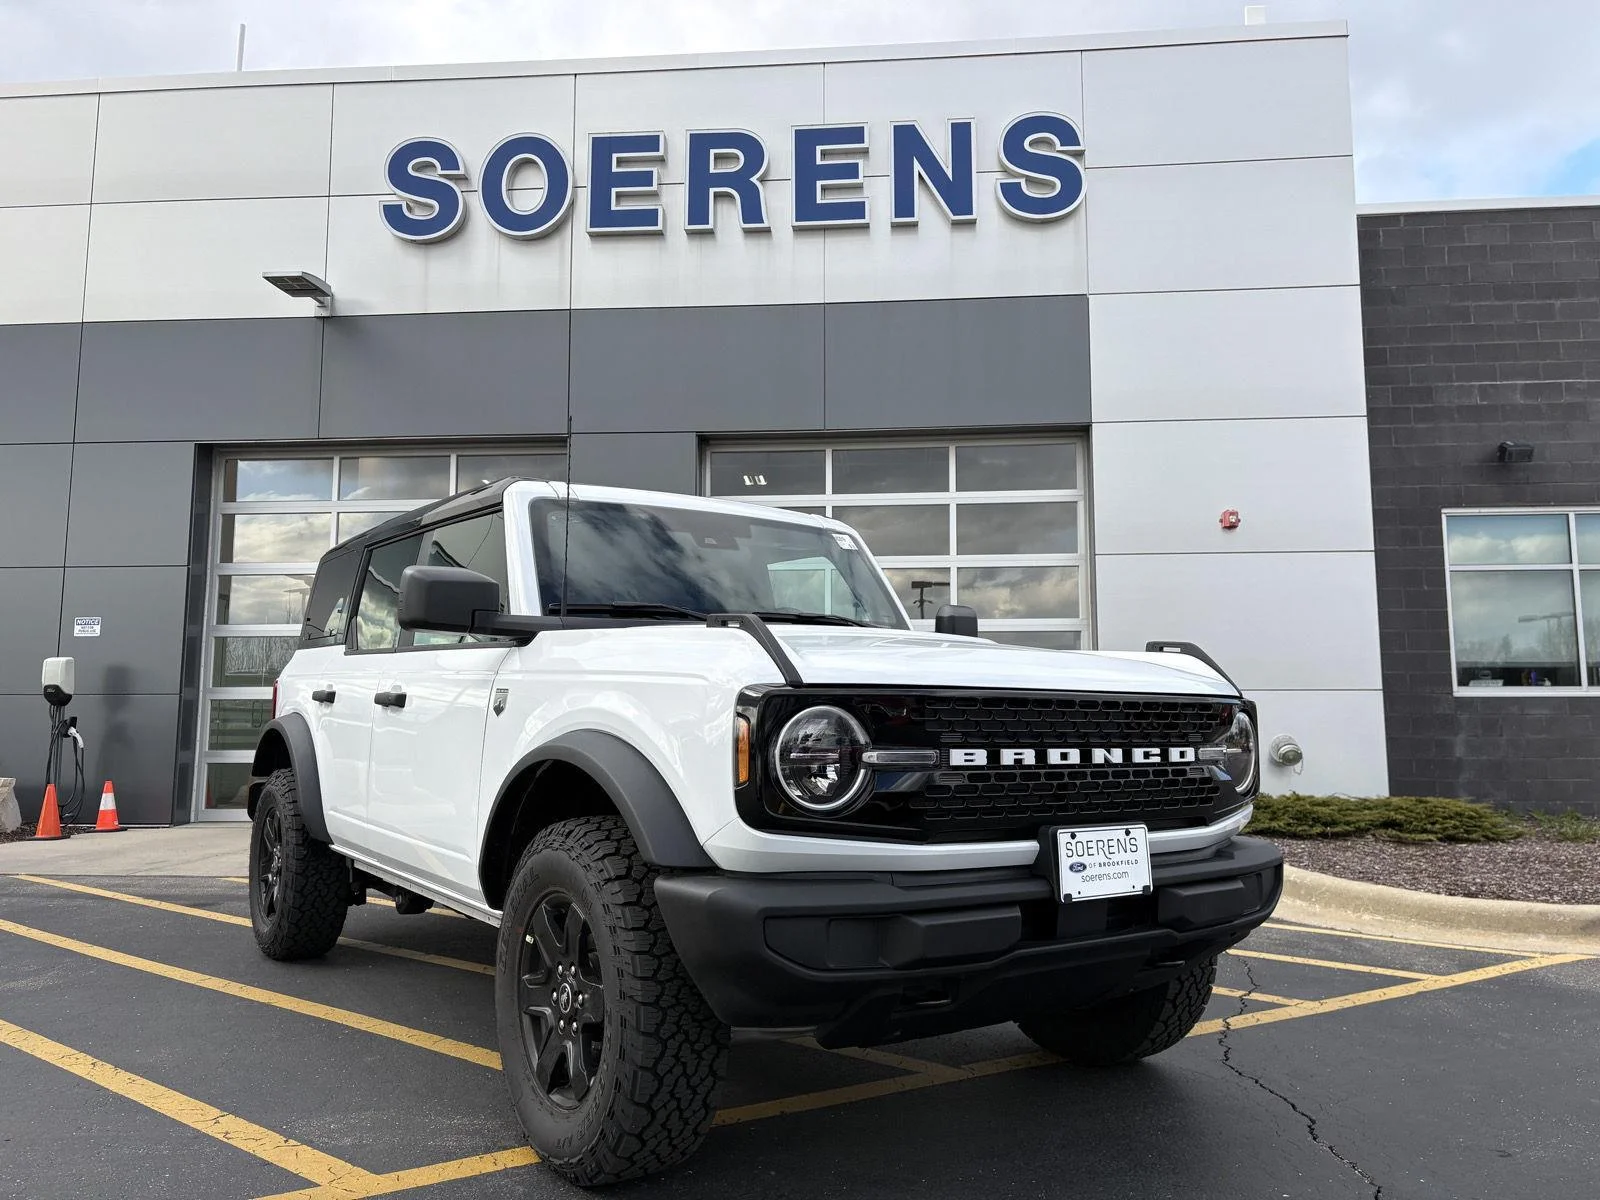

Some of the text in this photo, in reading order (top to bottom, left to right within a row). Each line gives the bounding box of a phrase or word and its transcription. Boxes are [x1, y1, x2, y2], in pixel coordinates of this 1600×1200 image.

[379, 111, 1087, 244] SOERENS
[949, 747, 1196, 766] BRONCO
[1065, 837, 1138, 860] SOERENS
[1098, 859, 1139, 868] BROOKFIELD
[1081, 871, 1130, 883] soerens.com
